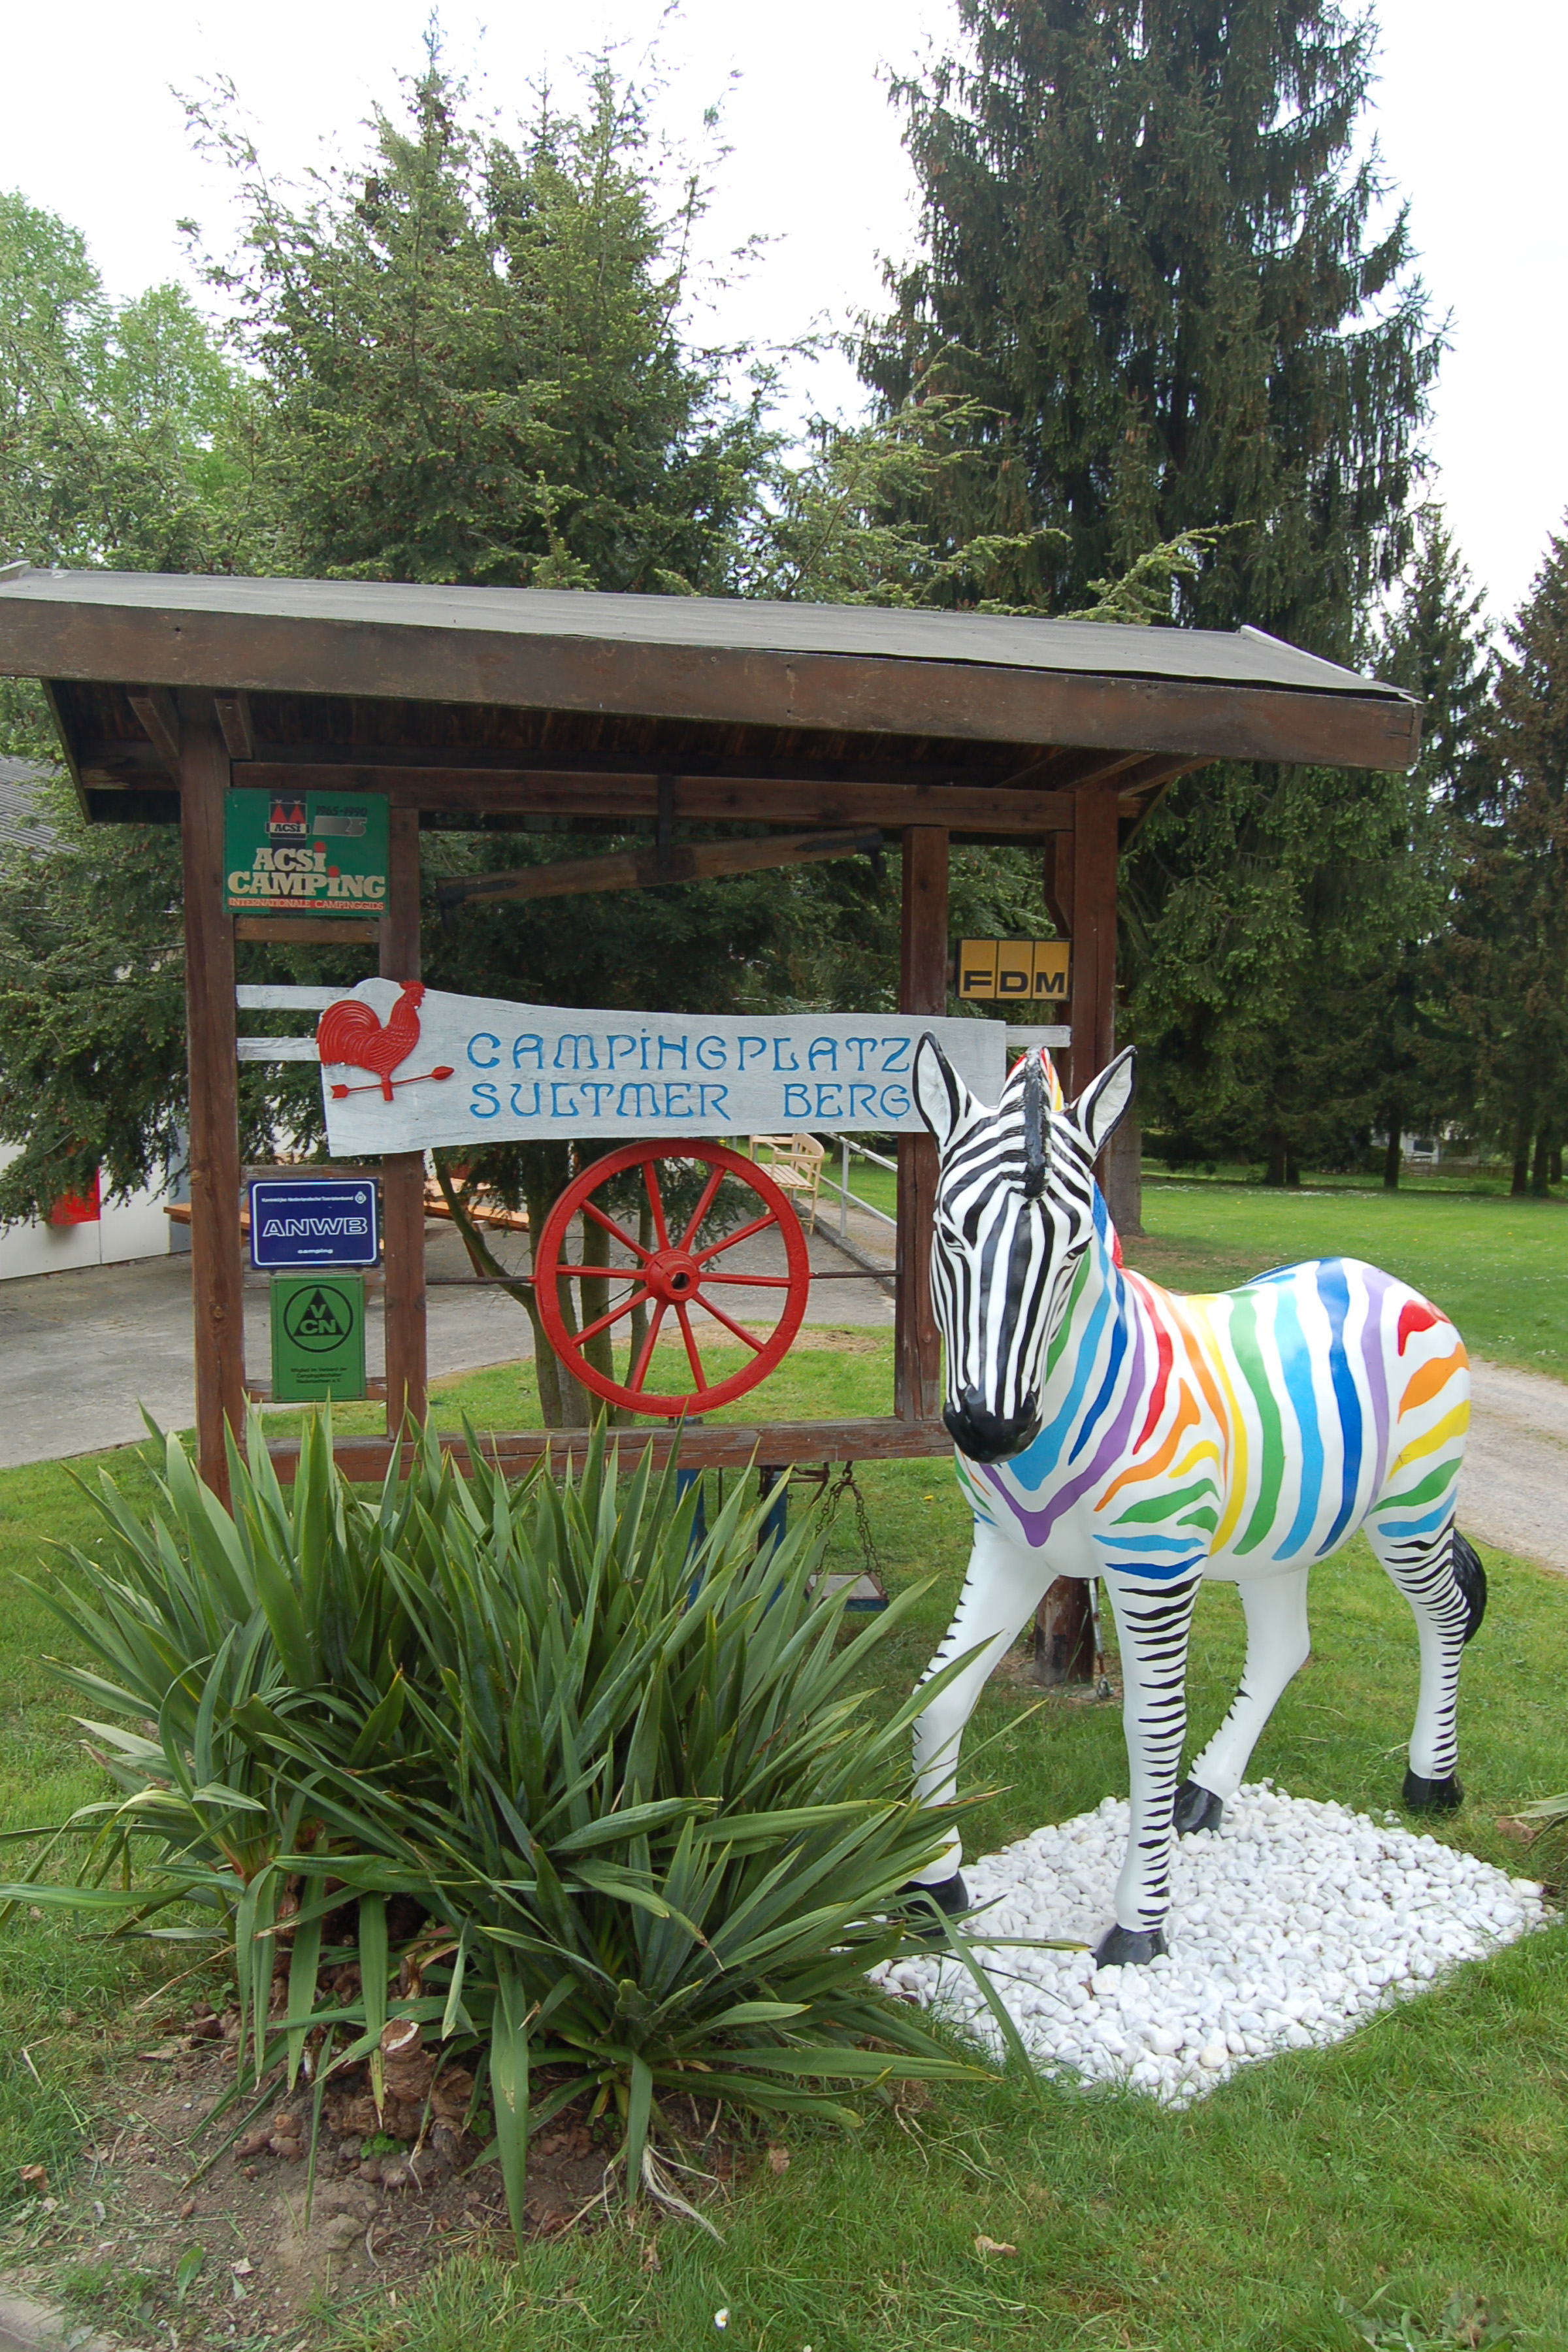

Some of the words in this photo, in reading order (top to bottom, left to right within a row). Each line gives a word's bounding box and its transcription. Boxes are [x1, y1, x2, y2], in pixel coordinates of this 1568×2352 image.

[316, 805, 368, 817] 1965-1990
[229, 898, 311, 908] INTERNATIONALE
[314, 900, 384, 911] CAMPINGGIDS
[963, 970, 1066, 993] FDM
[469, 1082, 731, 1121] SULTMER
[783, 1083, 911, 1122] BERG
[262, 1217, 368, 1237] ANWB
[310, 1304, 327, 1318] V
[300, 1319, 336, 1334] CN
